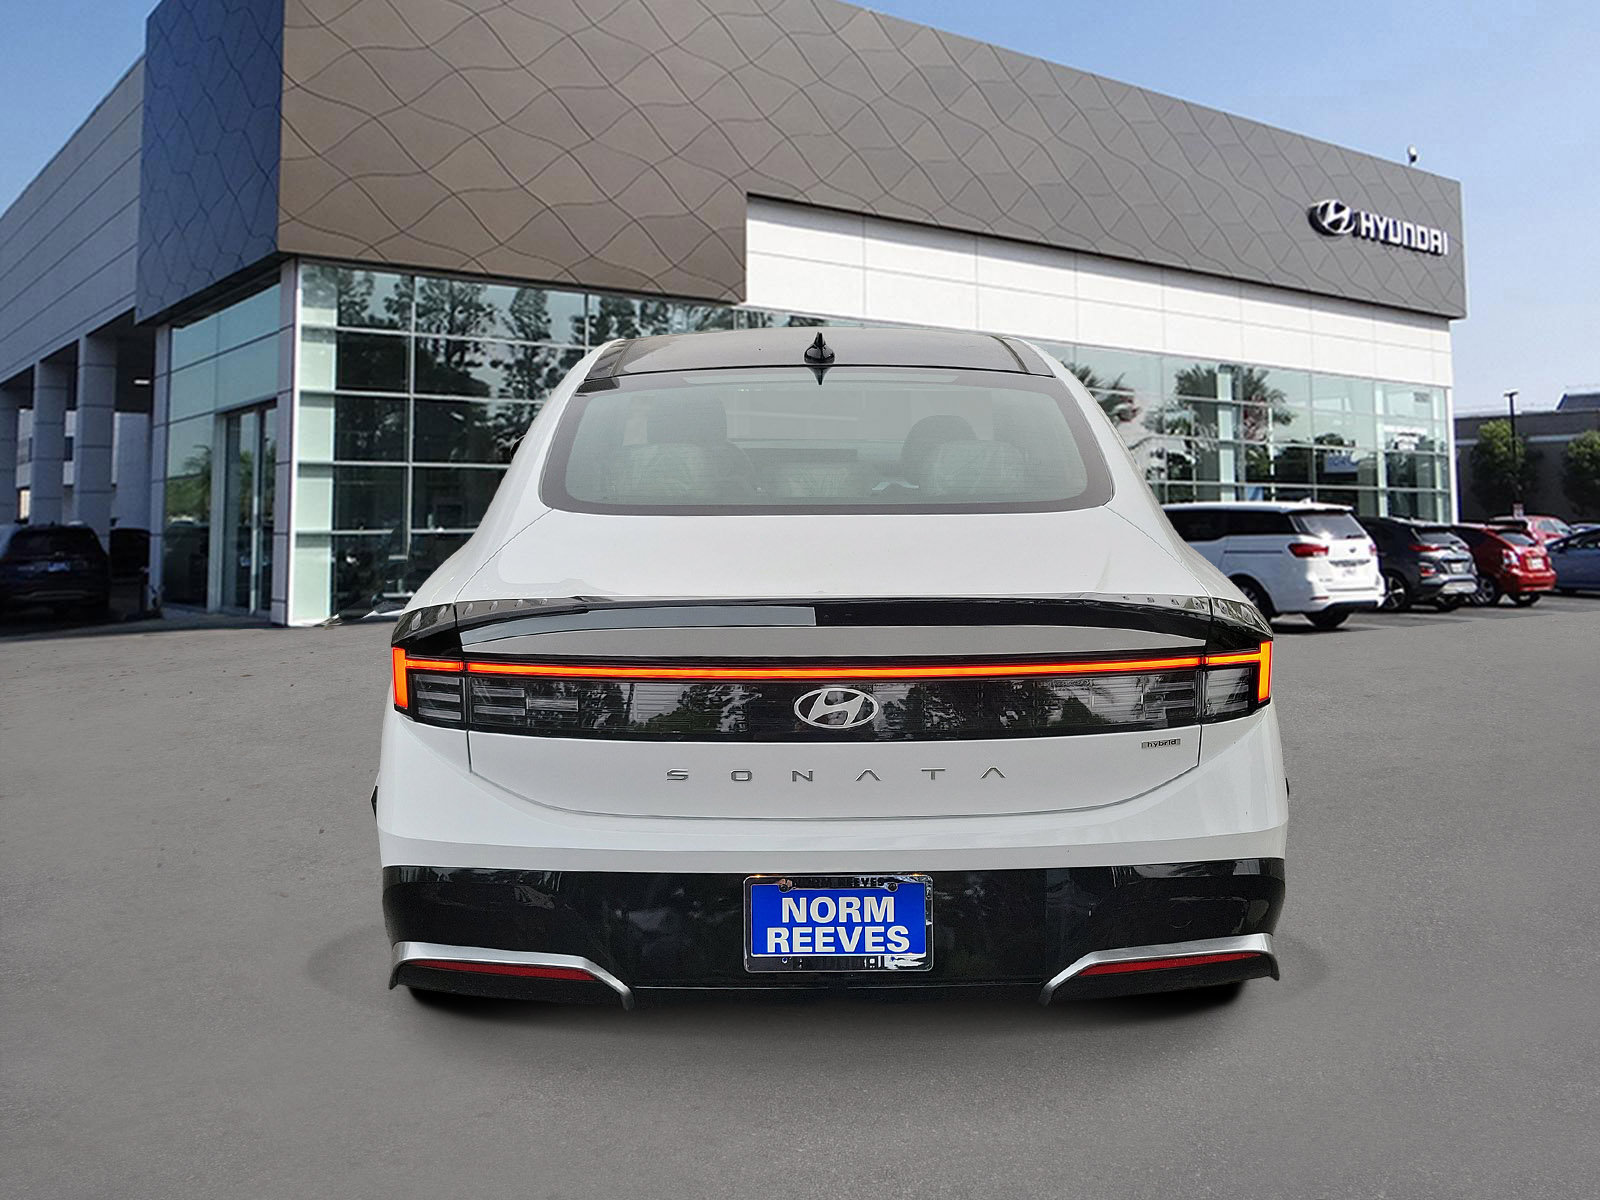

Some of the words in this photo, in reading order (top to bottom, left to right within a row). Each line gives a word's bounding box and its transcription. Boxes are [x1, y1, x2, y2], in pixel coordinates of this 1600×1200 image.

[1360, 211, 1448, 255] HYUNDAI
[1147, 739, 1177, 748] hybrid
[666, 766, 1006, 783] SONATA
[781, 896, 895, 923] NORM
[767, 925, 910, 953] REEVES
